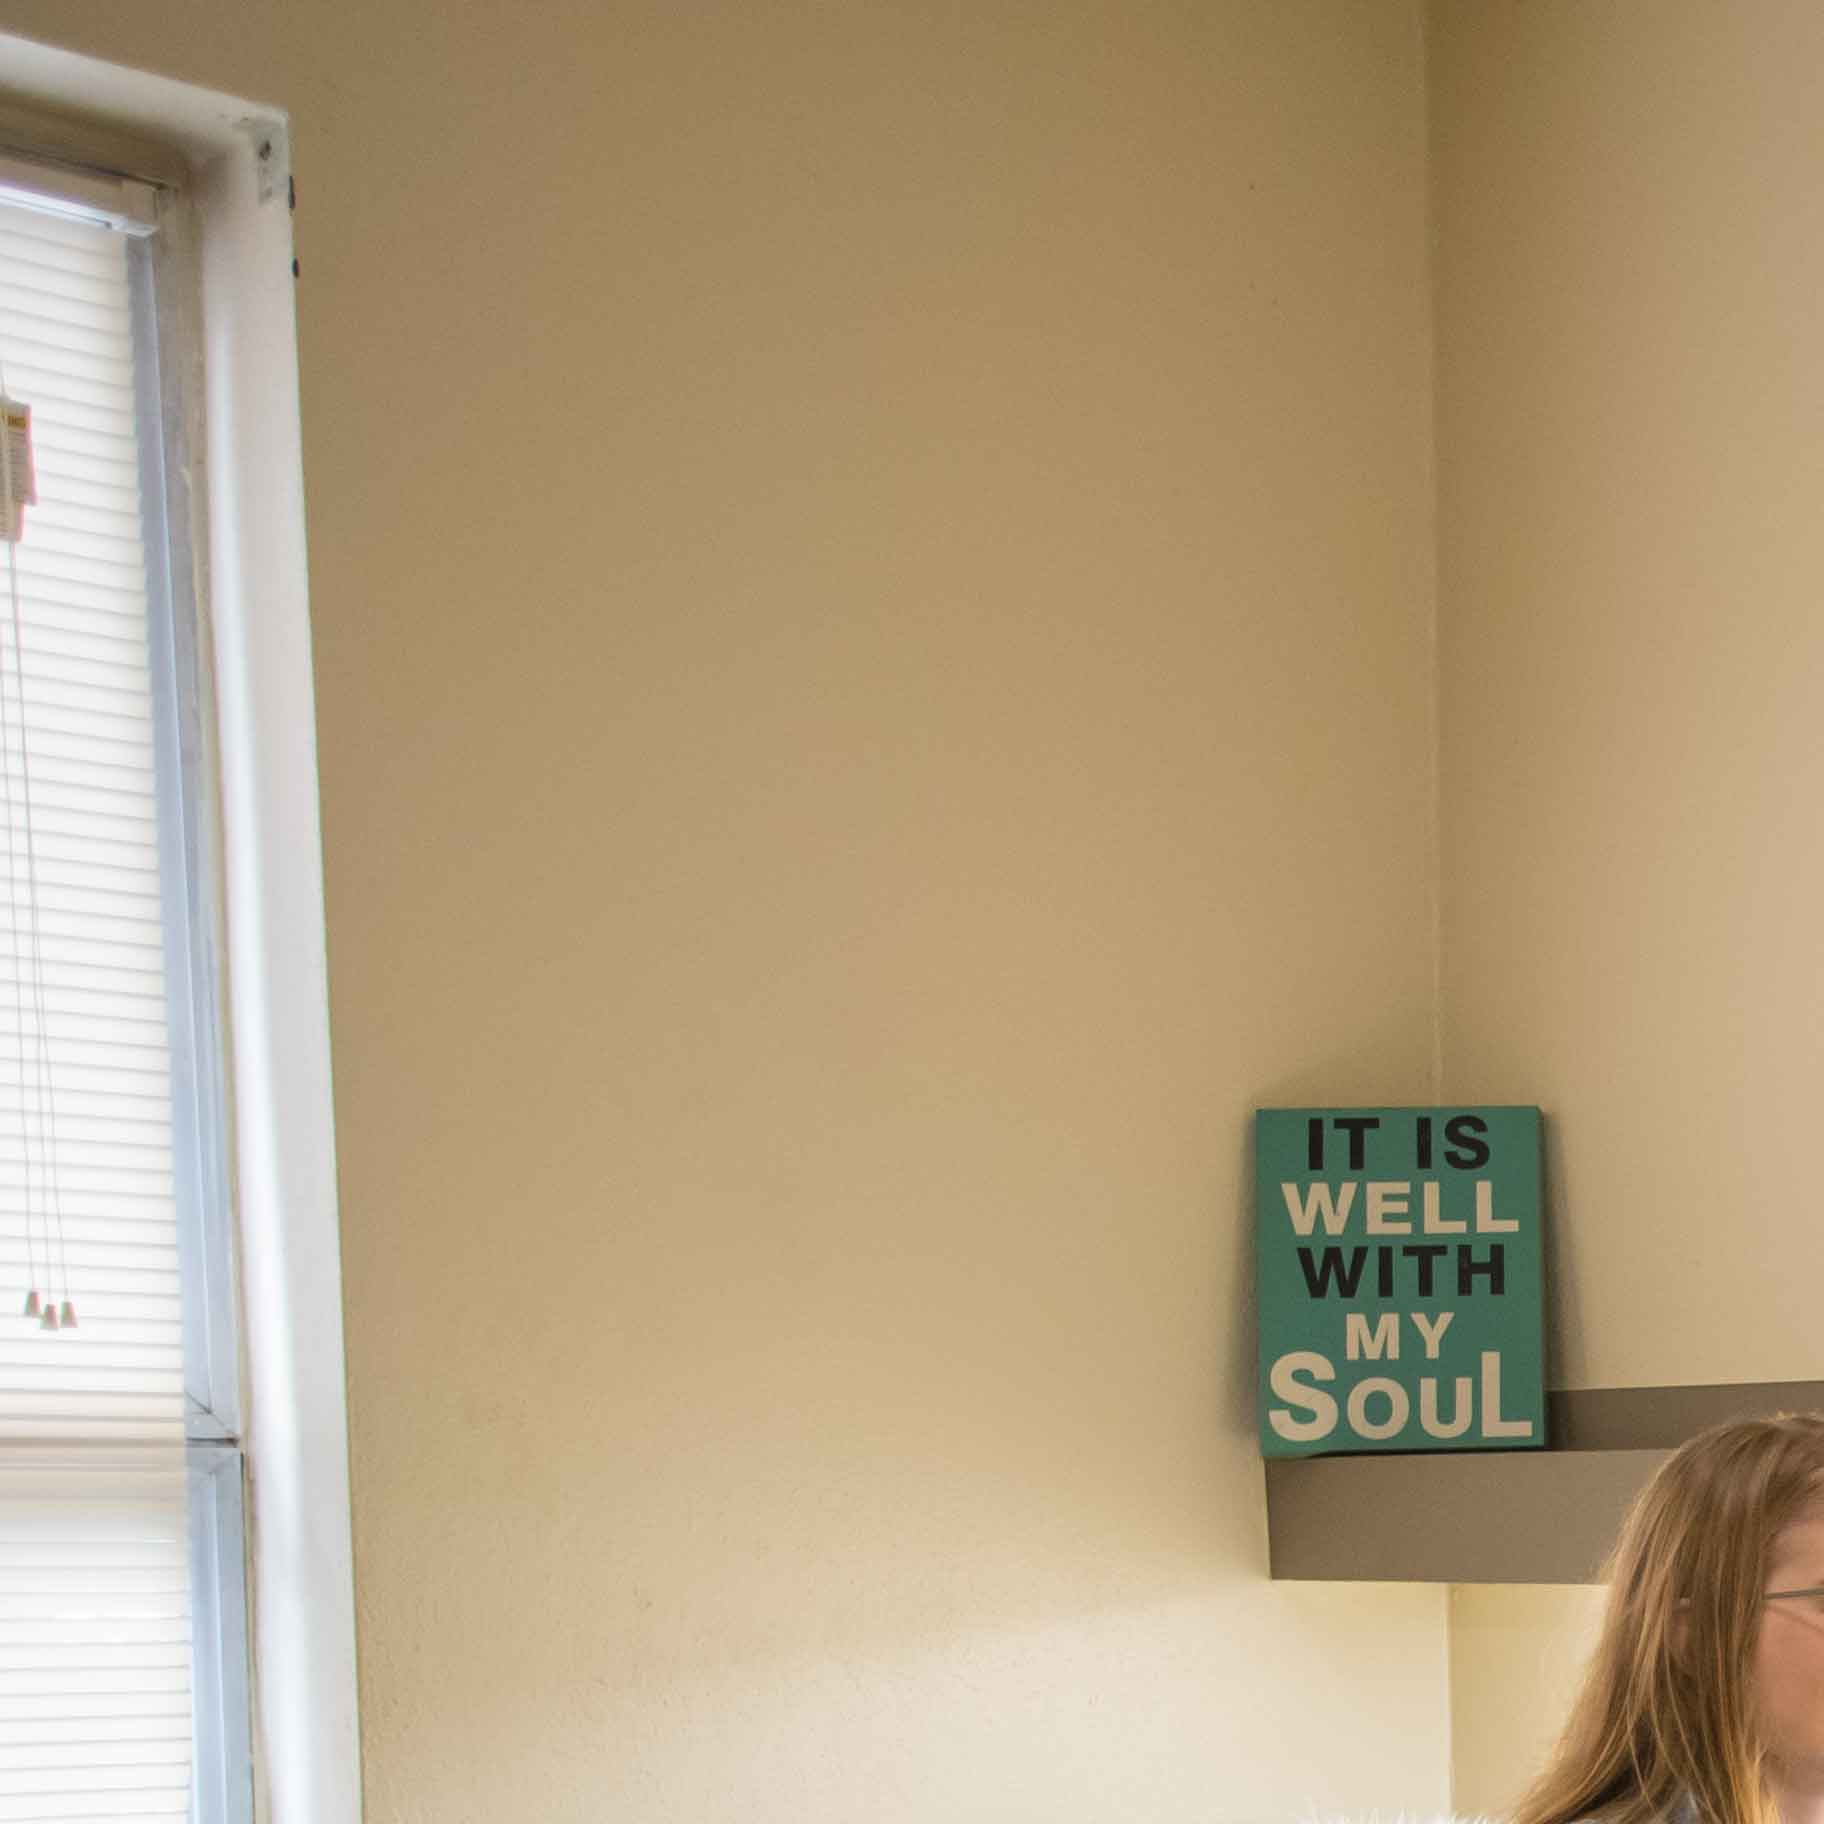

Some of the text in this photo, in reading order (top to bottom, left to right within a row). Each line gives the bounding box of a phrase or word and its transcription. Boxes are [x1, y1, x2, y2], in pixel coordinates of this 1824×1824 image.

[1307, 1115, 1490, 1170] IT IS
[1281, 1180, 1520, 1235] WELL
[1296, 1243, 1505, 1298] WITH
[1345, 1312, 1455, 1360] MY
